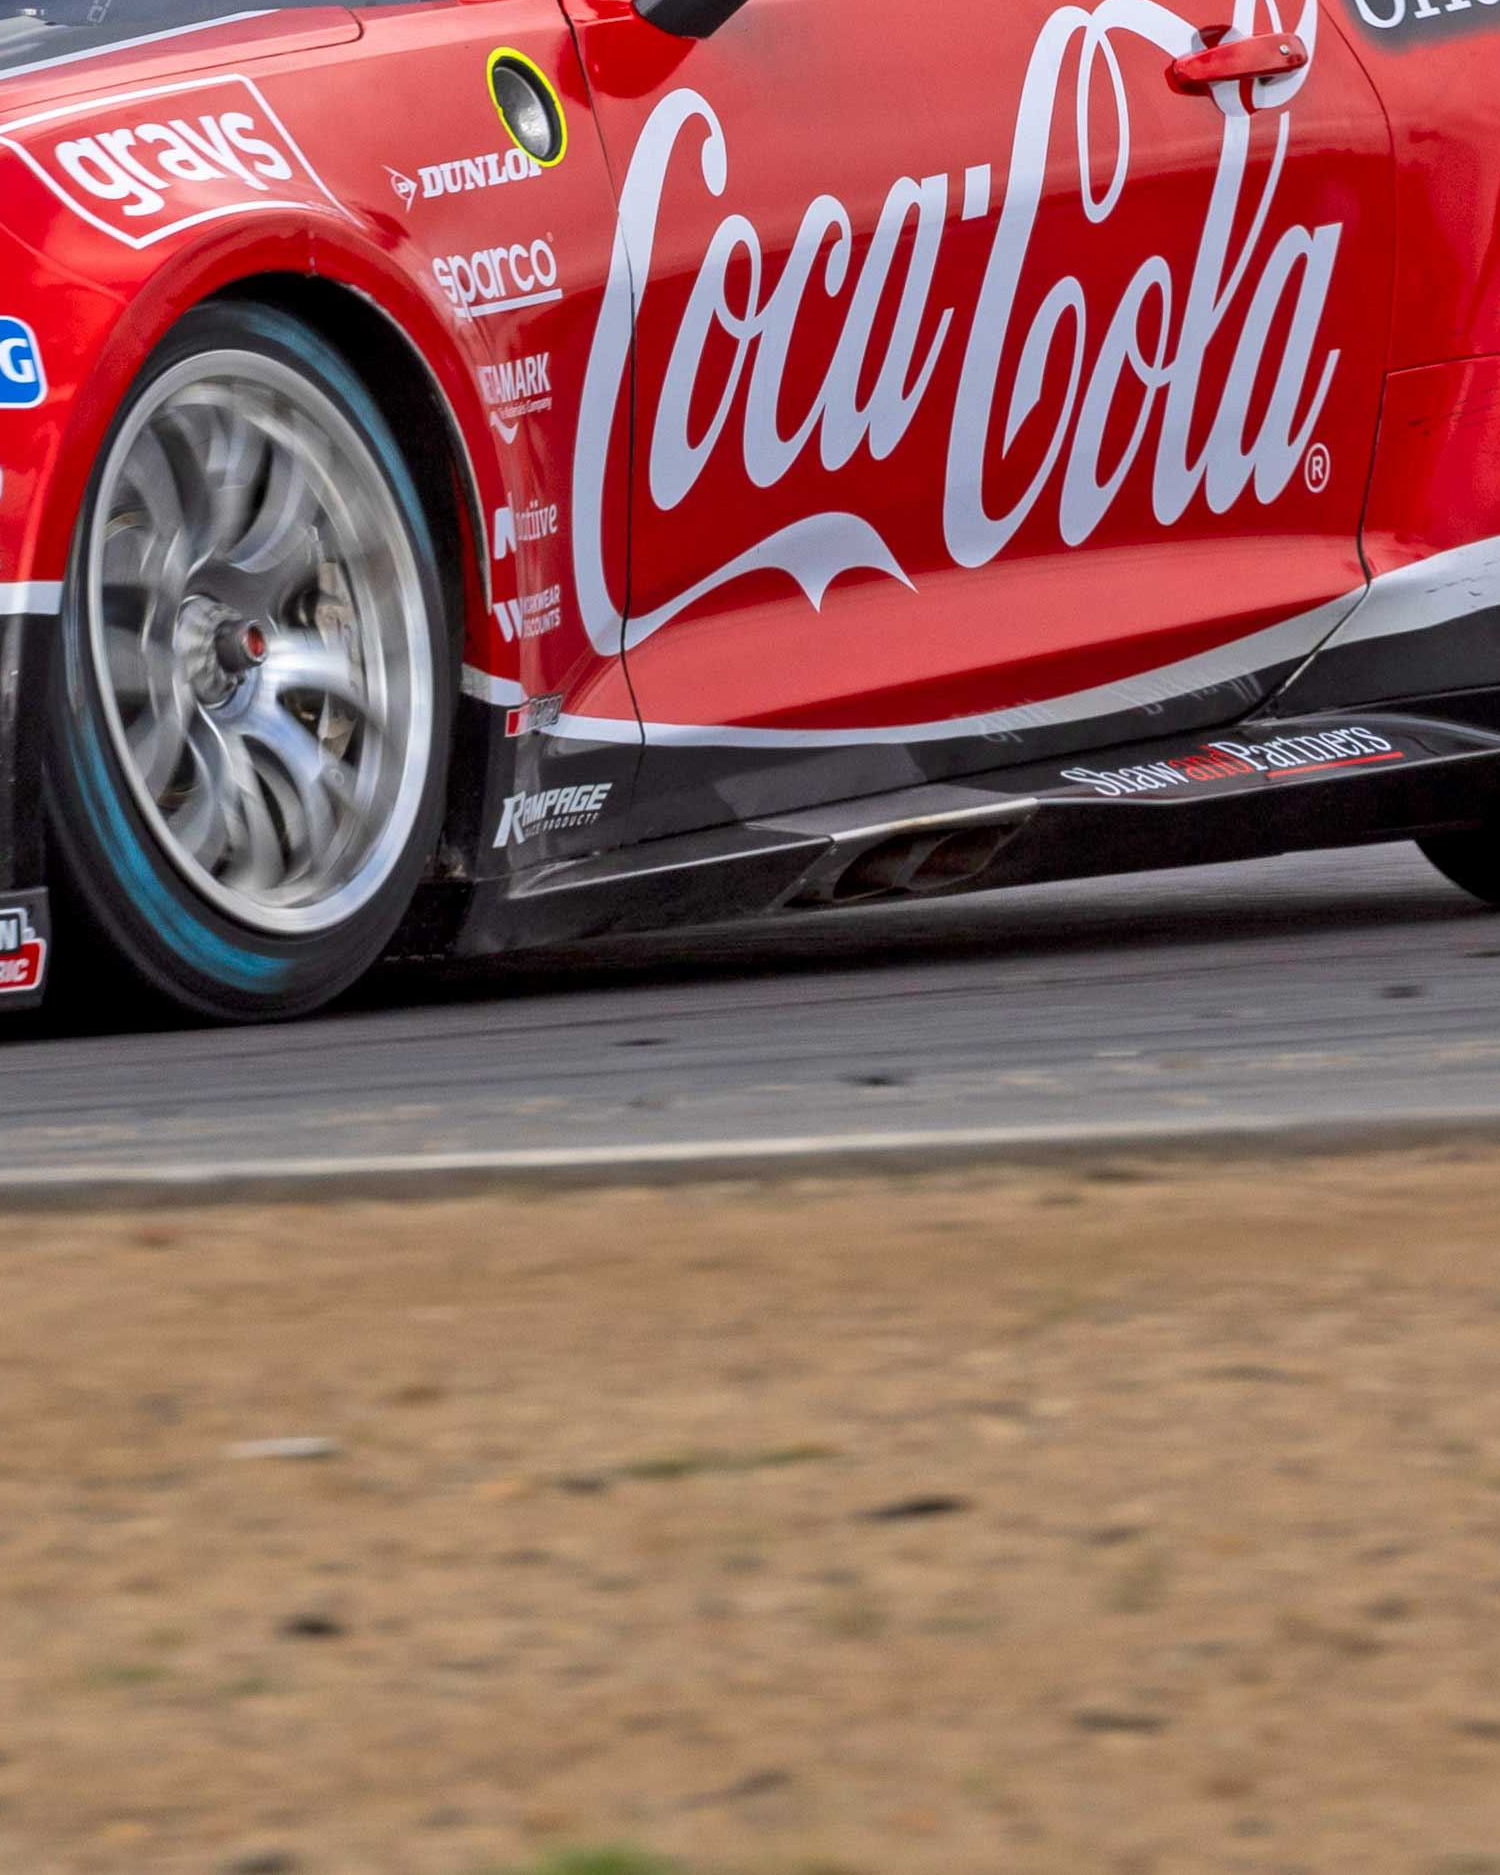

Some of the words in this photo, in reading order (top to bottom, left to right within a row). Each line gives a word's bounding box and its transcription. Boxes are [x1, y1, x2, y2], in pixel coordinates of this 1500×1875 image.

[55, 112, 292, 216] grays
[432, 238, 557, 322] sparco
[492, 782, 614, 848] RAMPAGE
[541, 813, 599, 833] PRODUCTS
